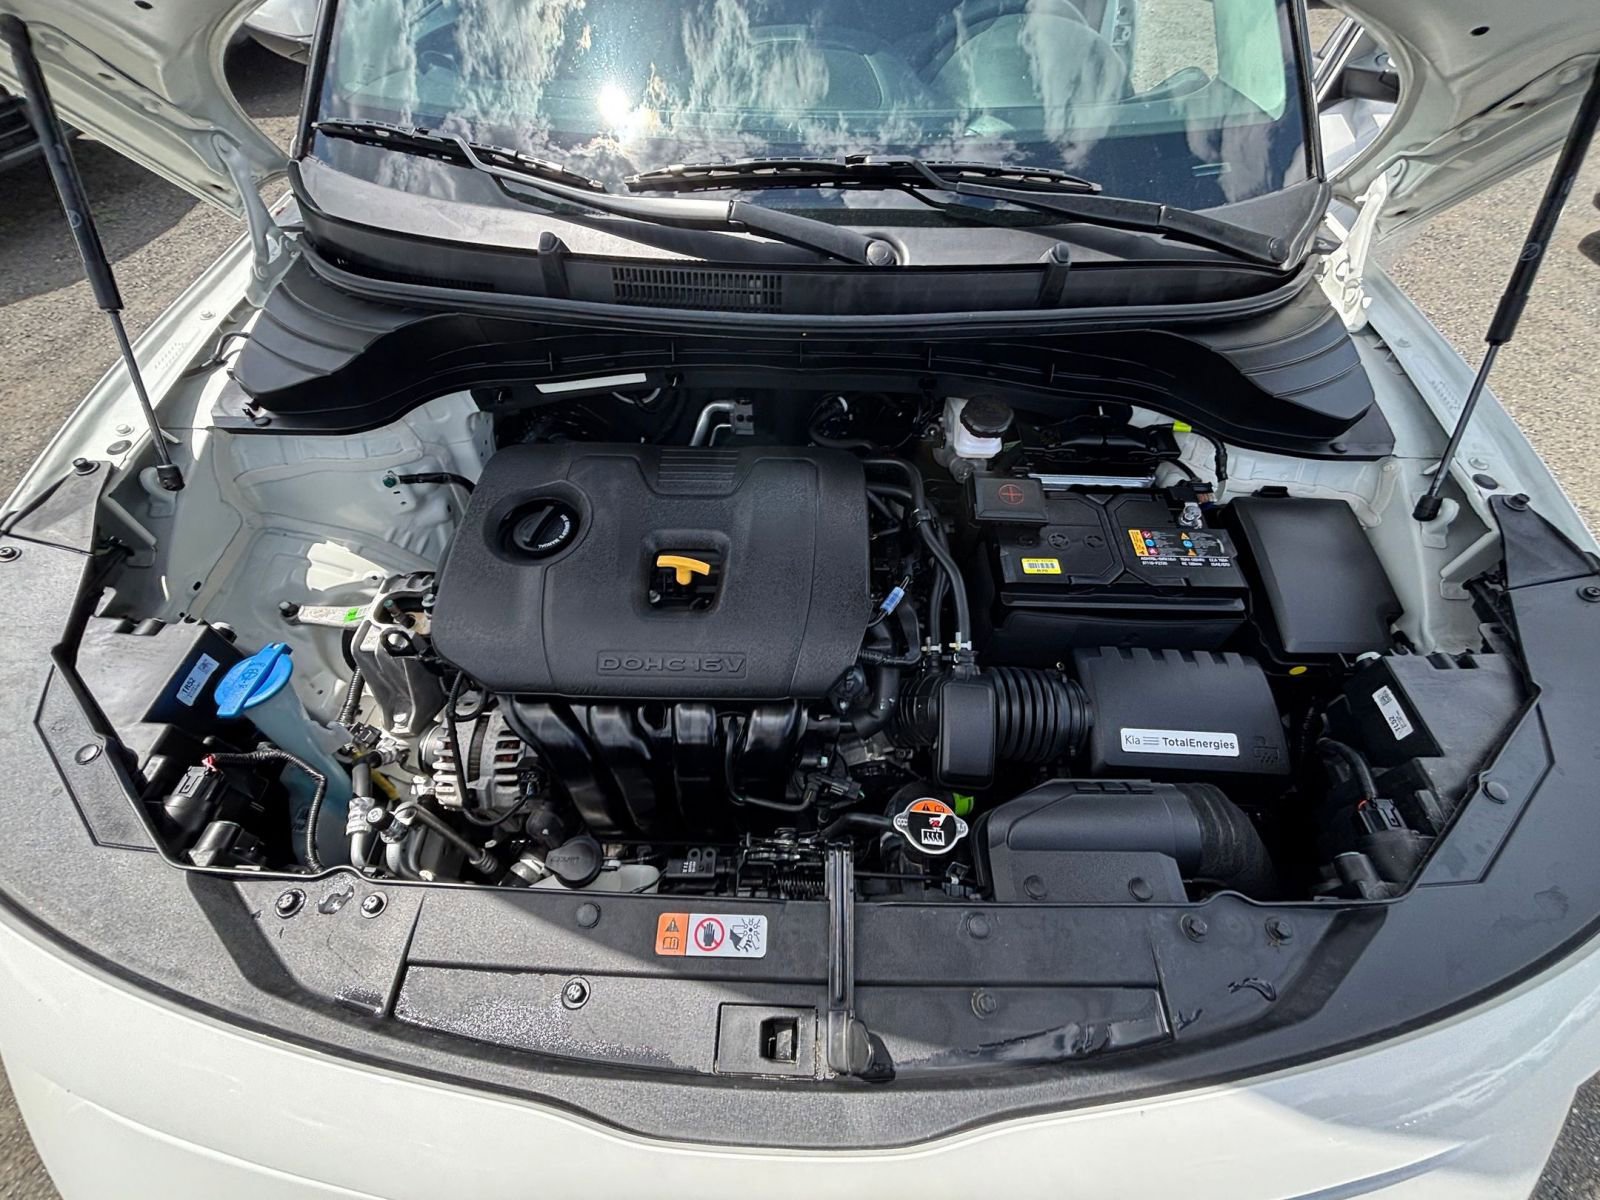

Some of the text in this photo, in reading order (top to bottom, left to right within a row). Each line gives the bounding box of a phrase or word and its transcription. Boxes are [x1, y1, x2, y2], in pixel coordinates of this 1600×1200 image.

[601, 657, 745, 673] DOHC 16V
[1124, 735, 1235, 751] Kia TotalEnergies
